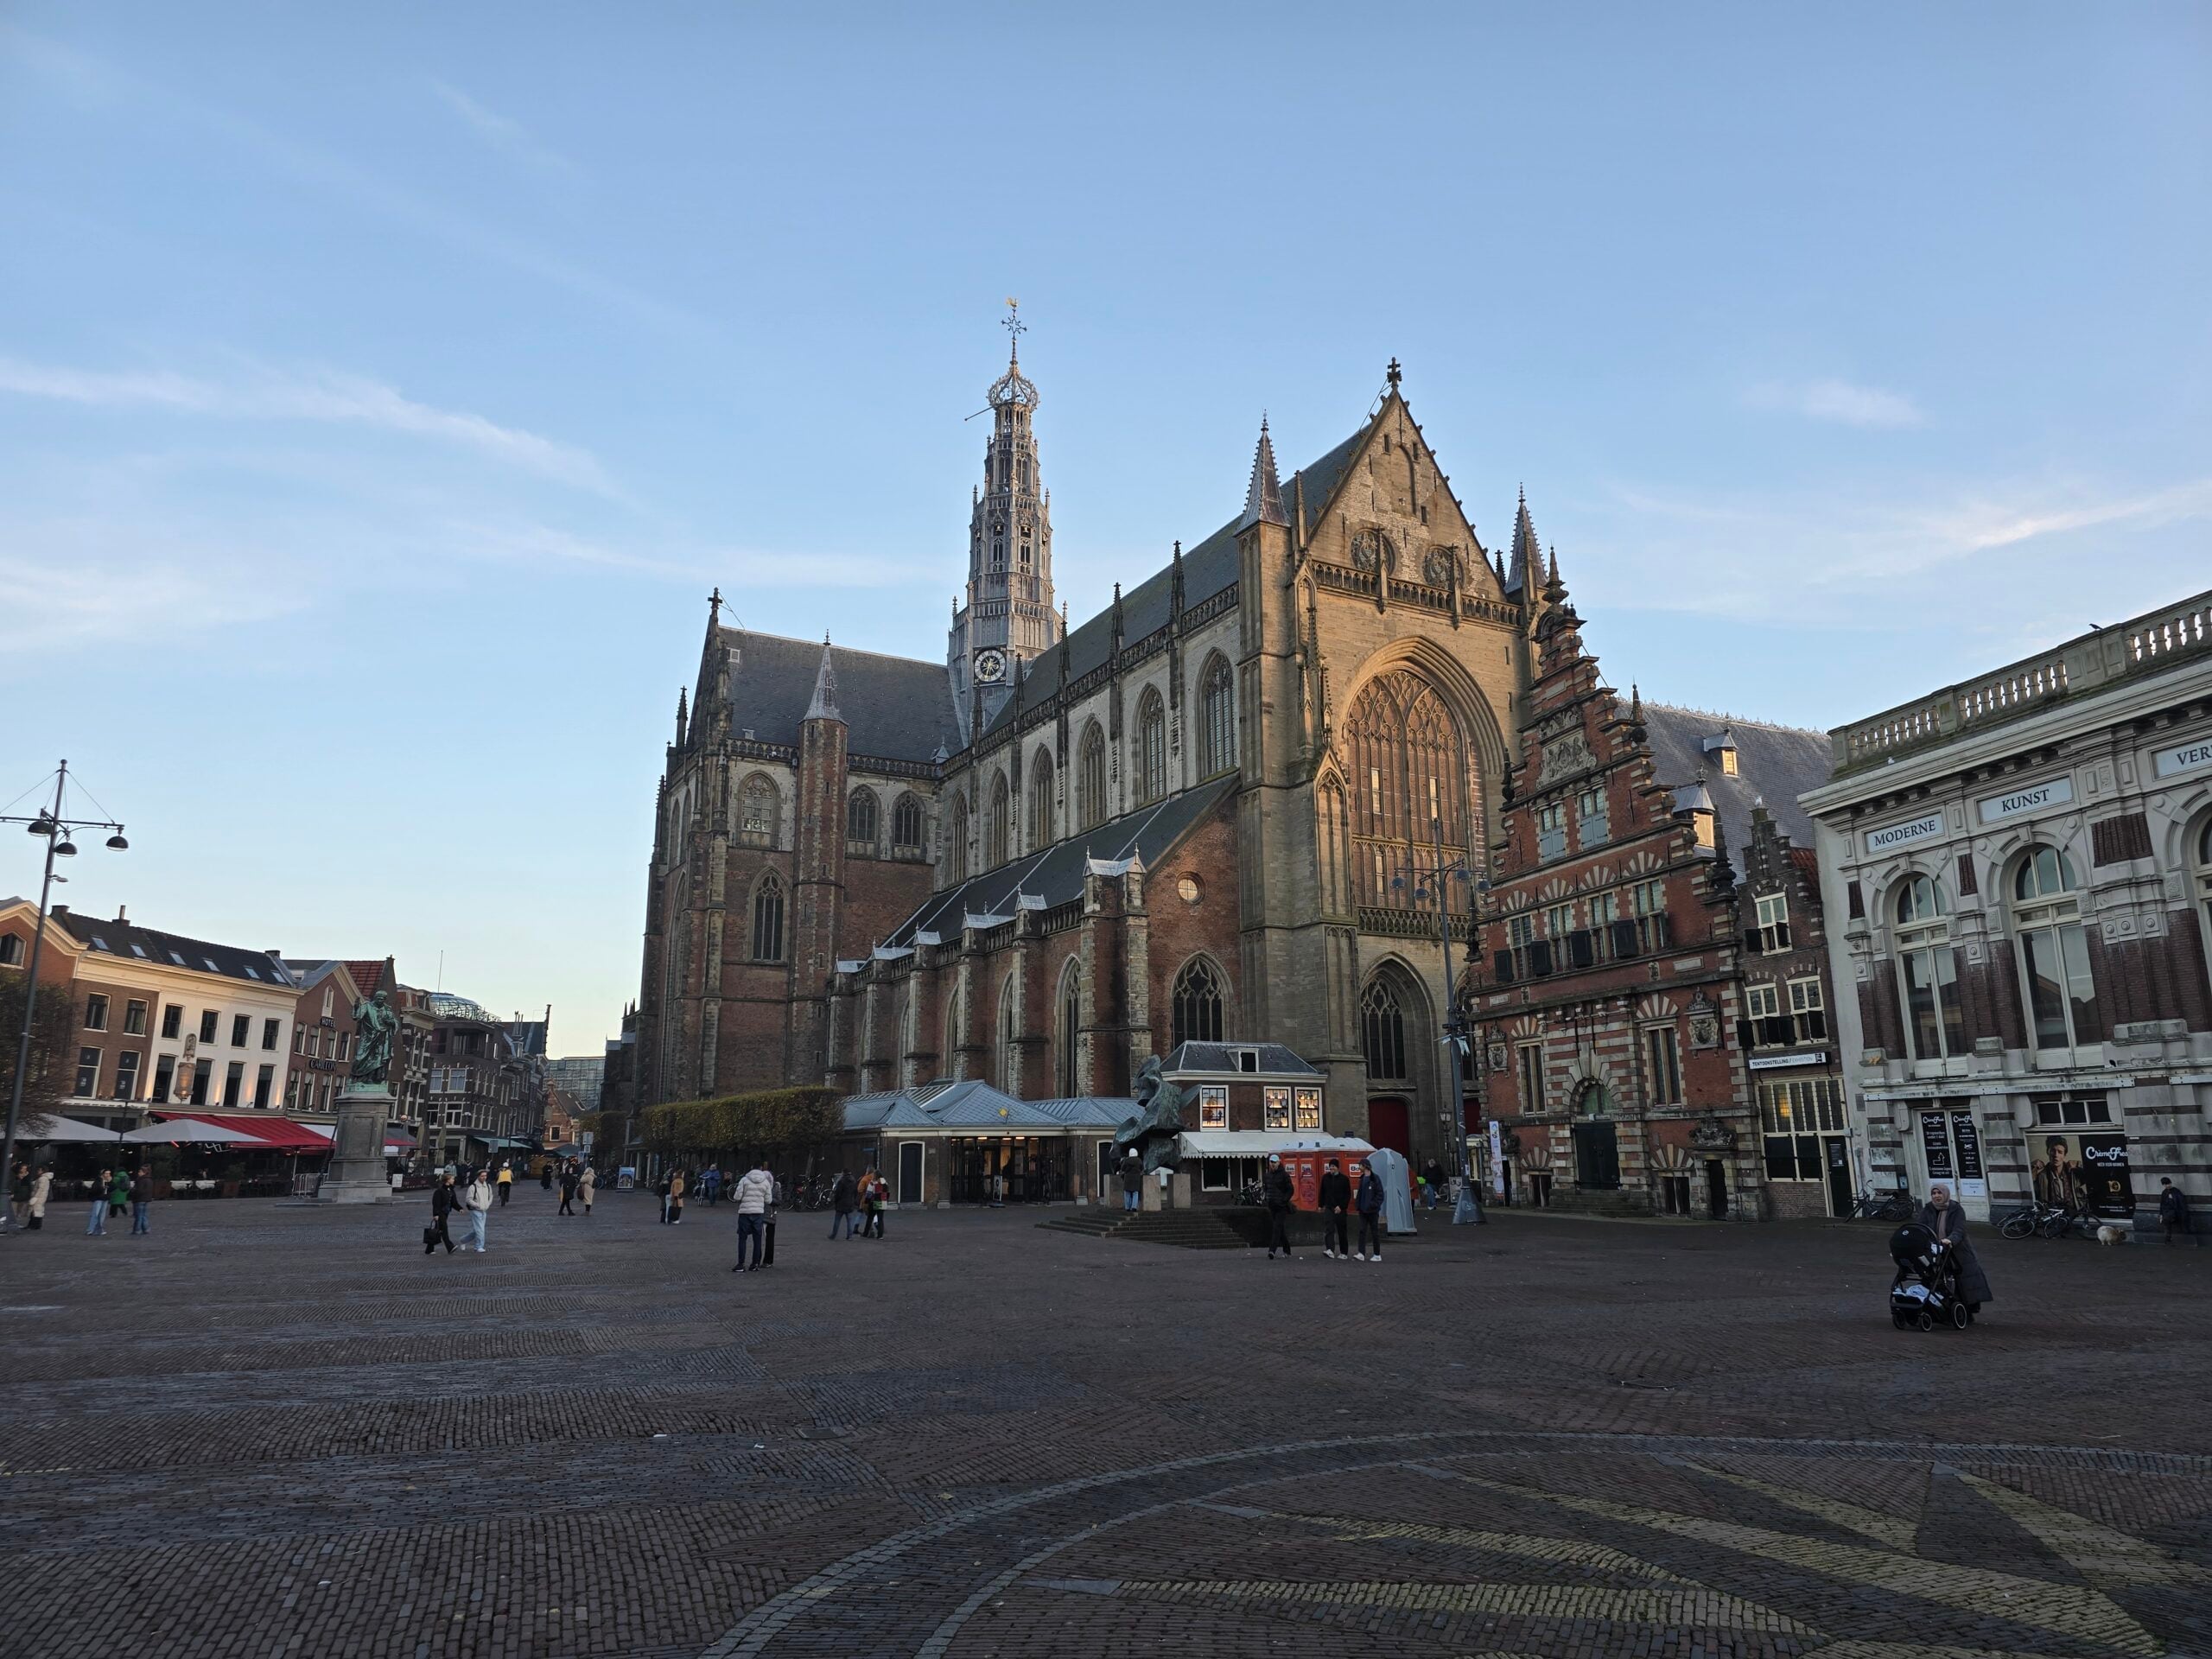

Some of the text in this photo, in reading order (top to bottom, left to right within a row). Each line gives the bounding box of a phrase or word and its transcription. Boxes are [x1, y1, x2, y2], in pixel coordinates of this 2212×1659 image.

[2177, 745, 2212, 766] VER
[2000, 788, 2050, 812] KUNST
[1873, 819, 1936, 847] MODERNE
[321, 1018, 336, 1028] HOTEL
